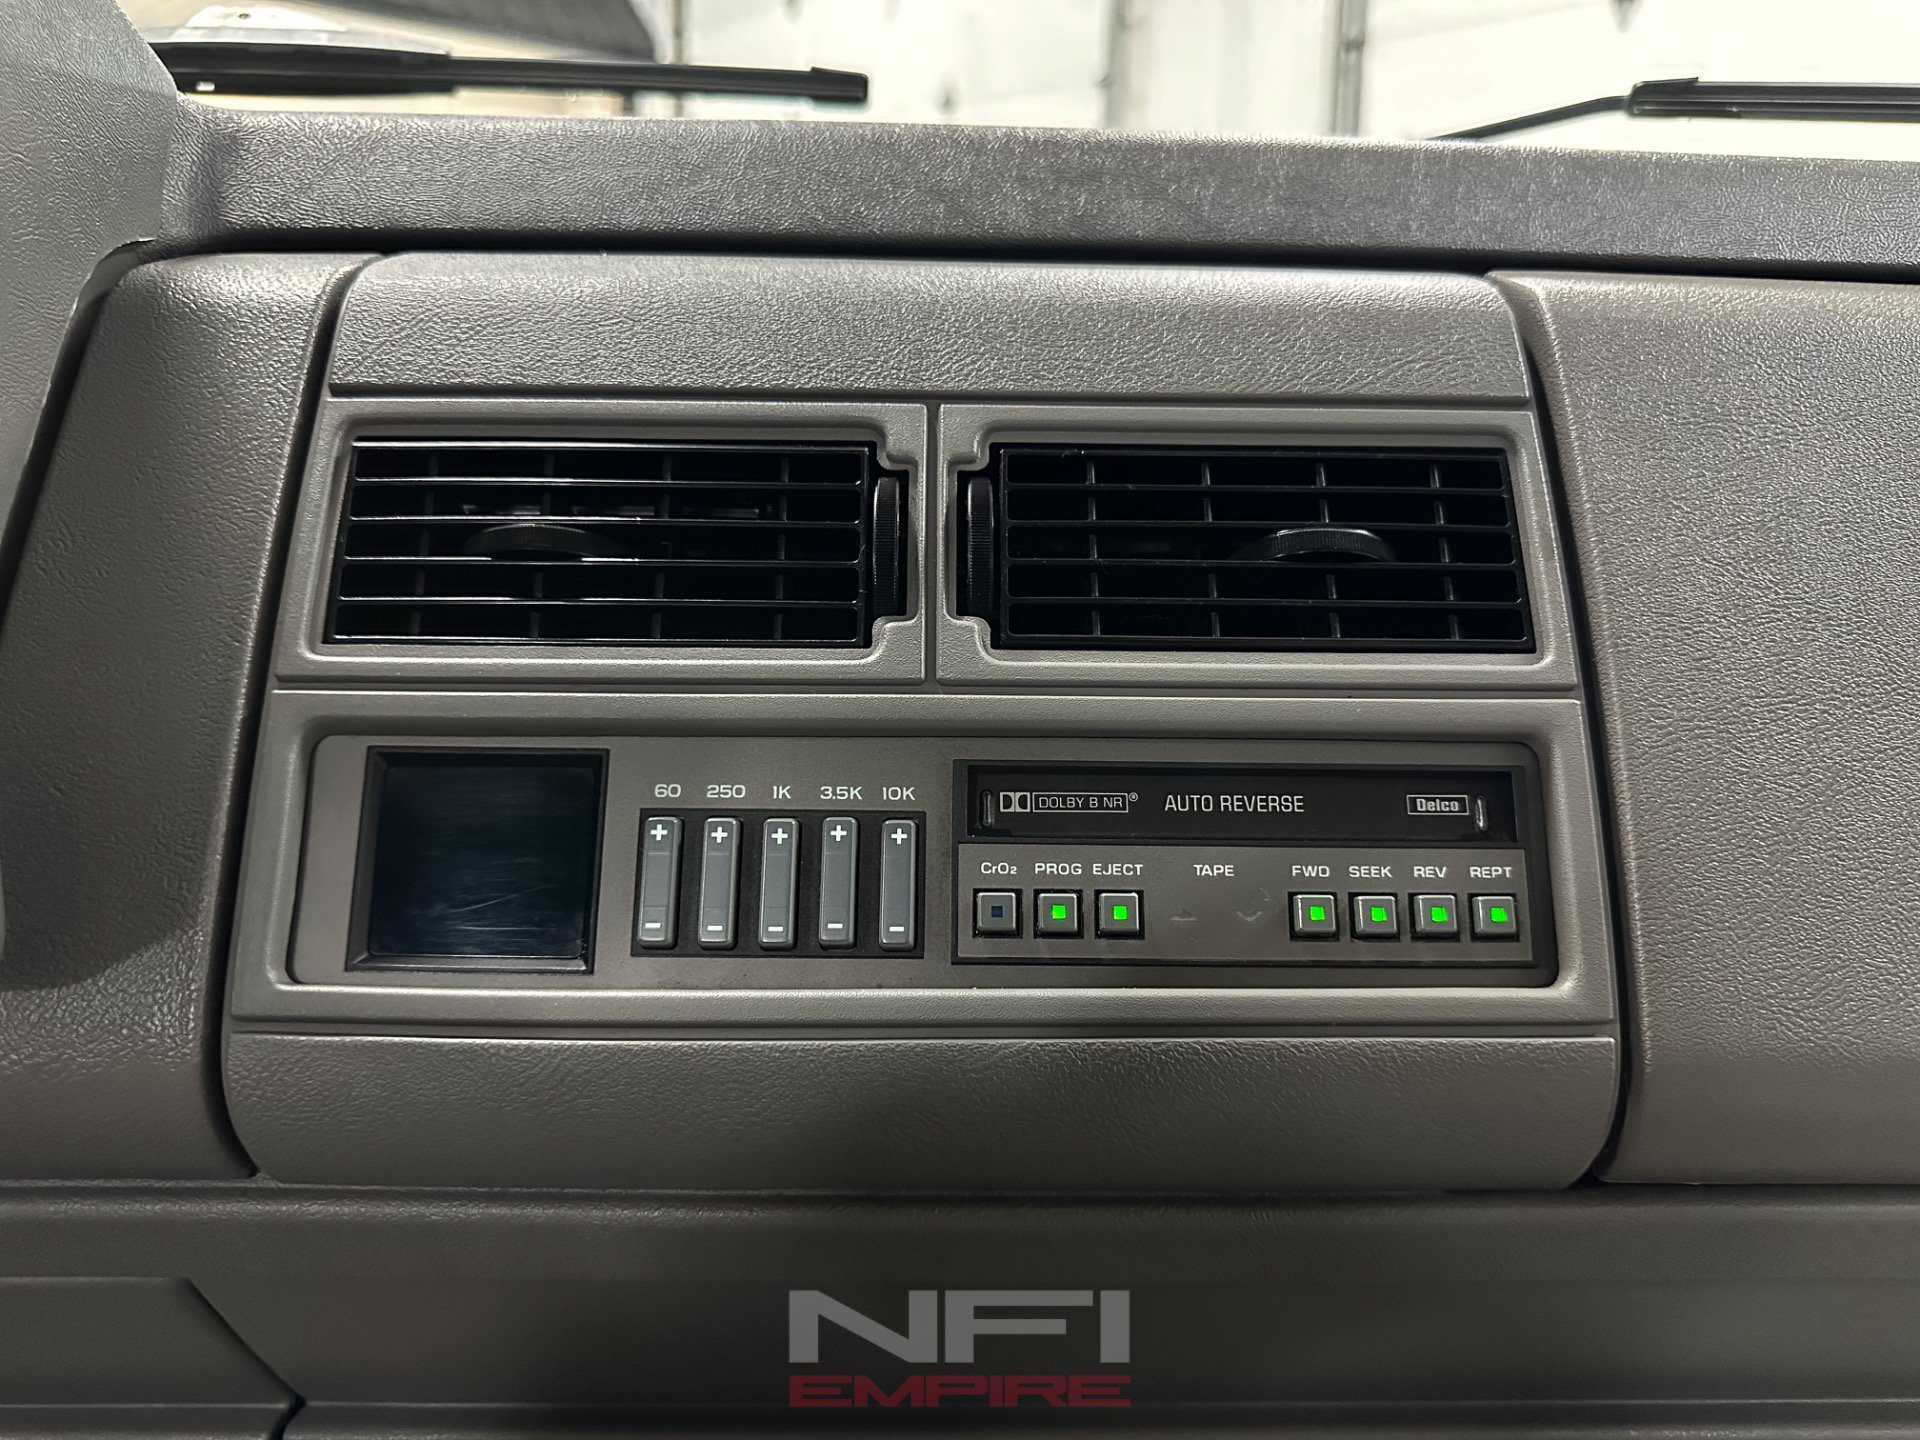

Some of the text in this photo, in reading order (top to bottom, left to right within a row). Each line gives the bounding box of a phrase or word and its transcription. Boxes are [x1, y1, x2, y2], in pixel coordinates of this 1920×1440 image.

[654, 784, 682, 798] 60
[706, 784, 746, 798] 250
[772, 785, 791, 799] 1K
[820, 786, 863, 800] 3.5K
[882, 786, 915, 801] 10K
[1038, 796, 1085, 809] DOLBY
[1089, 796, 1099, 809] B
[1164, 794, 1305, 813] AUTO REVERSE
[1416, 798, 1459, 812] Delco
[1034, 862, 1083, 876] PROG
[1092, 863, 1144, 876] EJECT
[1193, 864, 1235, 877] TAPE
[1291, 865, 1331, 878] FWD
[1348, 865, 1393, 878] SEEK
[1413, 866, 1447, 879] REV
[1469, 866, 1513, 879] REPT
